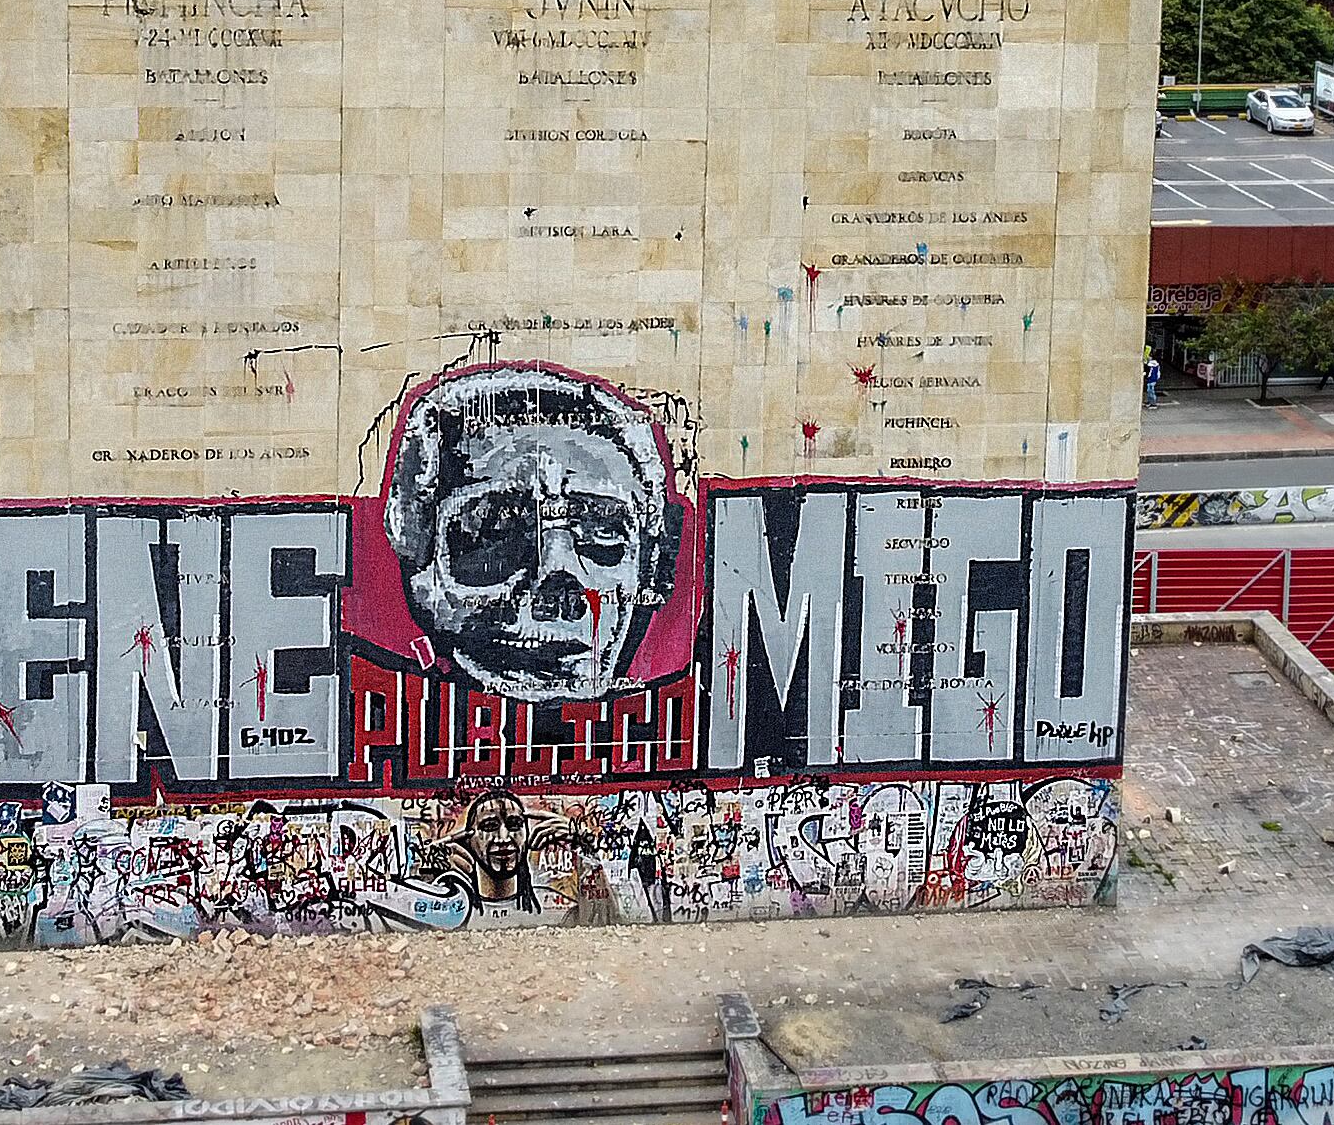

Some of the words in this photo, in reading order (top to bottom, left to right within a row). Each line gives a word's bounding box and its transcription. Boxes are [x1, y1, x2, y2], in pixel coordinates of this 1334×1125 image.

[930, 253, 948, 266] DE
[1165, 284, 1223, 309] rebaja
[890, 457, 952, 471] PRIMERO
[988, 817, 1006, 832] NO
[1008, 819, 1026, 832] LO
